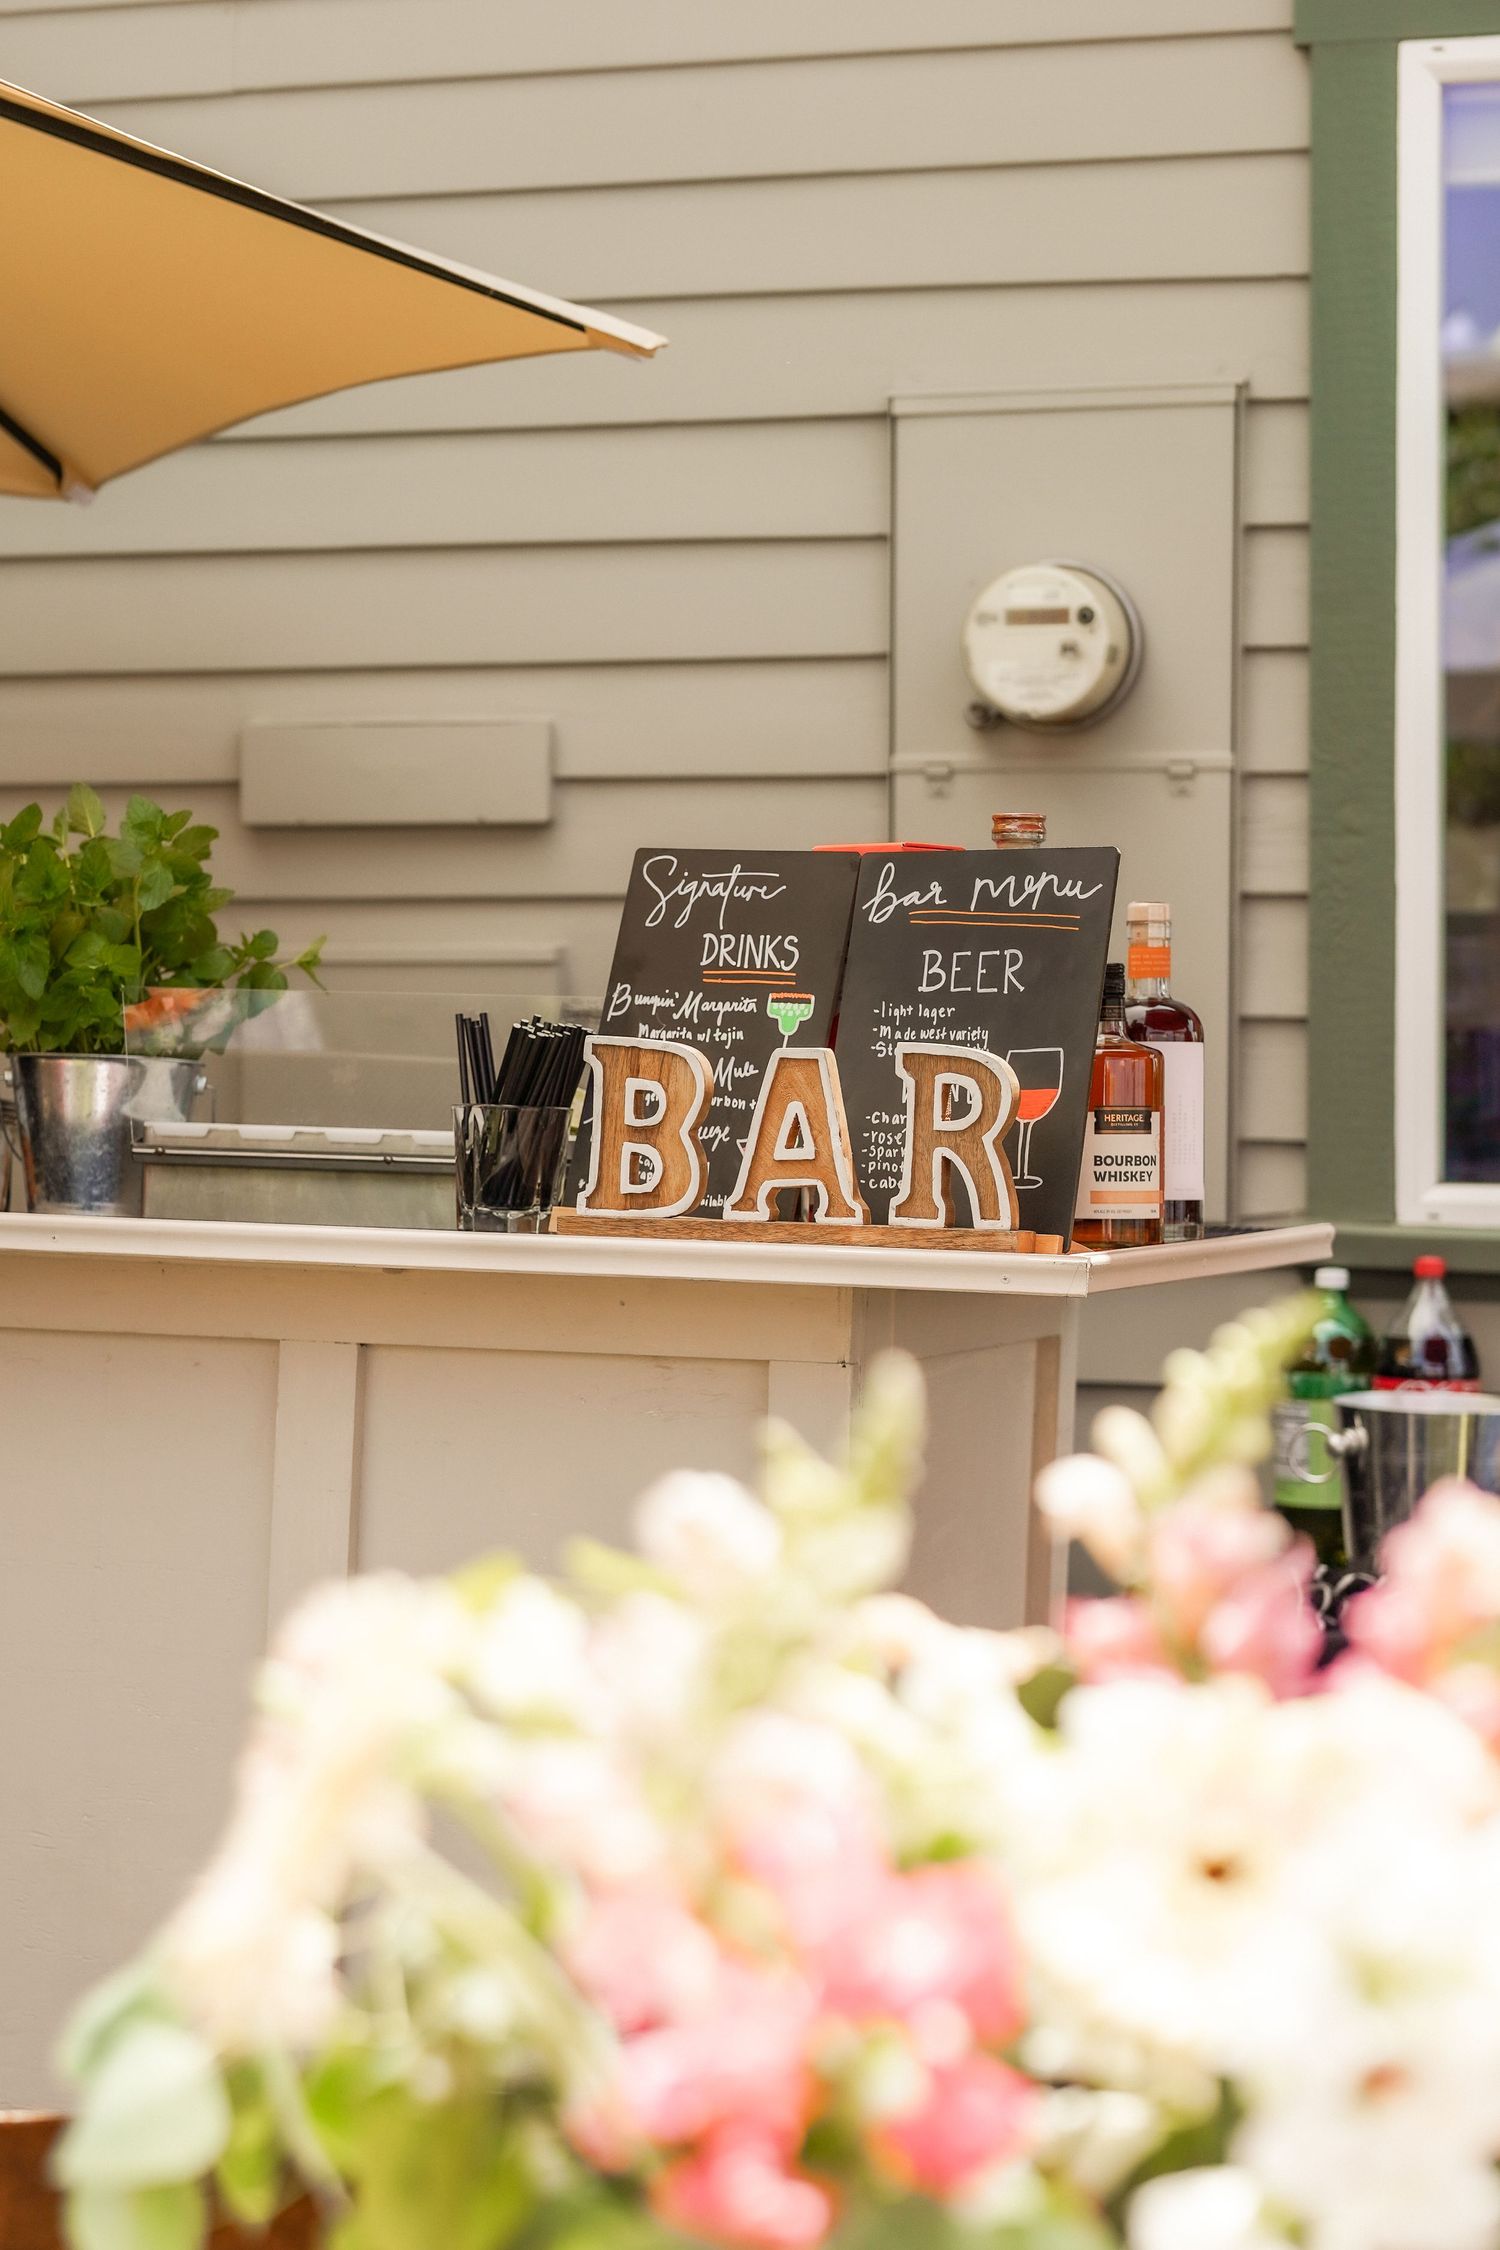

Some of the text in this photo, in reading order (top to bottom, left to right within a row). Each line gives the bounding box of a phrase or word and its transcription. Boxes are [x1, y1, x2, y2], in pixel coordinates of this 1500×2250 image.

[642, 855, 787, 930] Signature
[862, 861, 1104, 924] bar menu
[700, 933, 800, 972] DRINKS
[917, 948, 1025, 995] BEER
[672, 990, 758, 1027] Margarita
[918, 1003, 956, 1026] lager
[638, 1022, 693, 1042] Margarita
[713, 1026, 745, 1050] tajin
[919, 1026, 947, 1040] west
[949, 1026, 990, 1050] variety
[713, 1056, 760, 1092] Mule
[576, 1034, 1020, 1232] BAR
[1104, 1114, 1145, 1122] HERITAGE
[1093, 1155, 1157, 1167] BOURBON
[1093, 1170, 1153, 1182] WHISKEY
